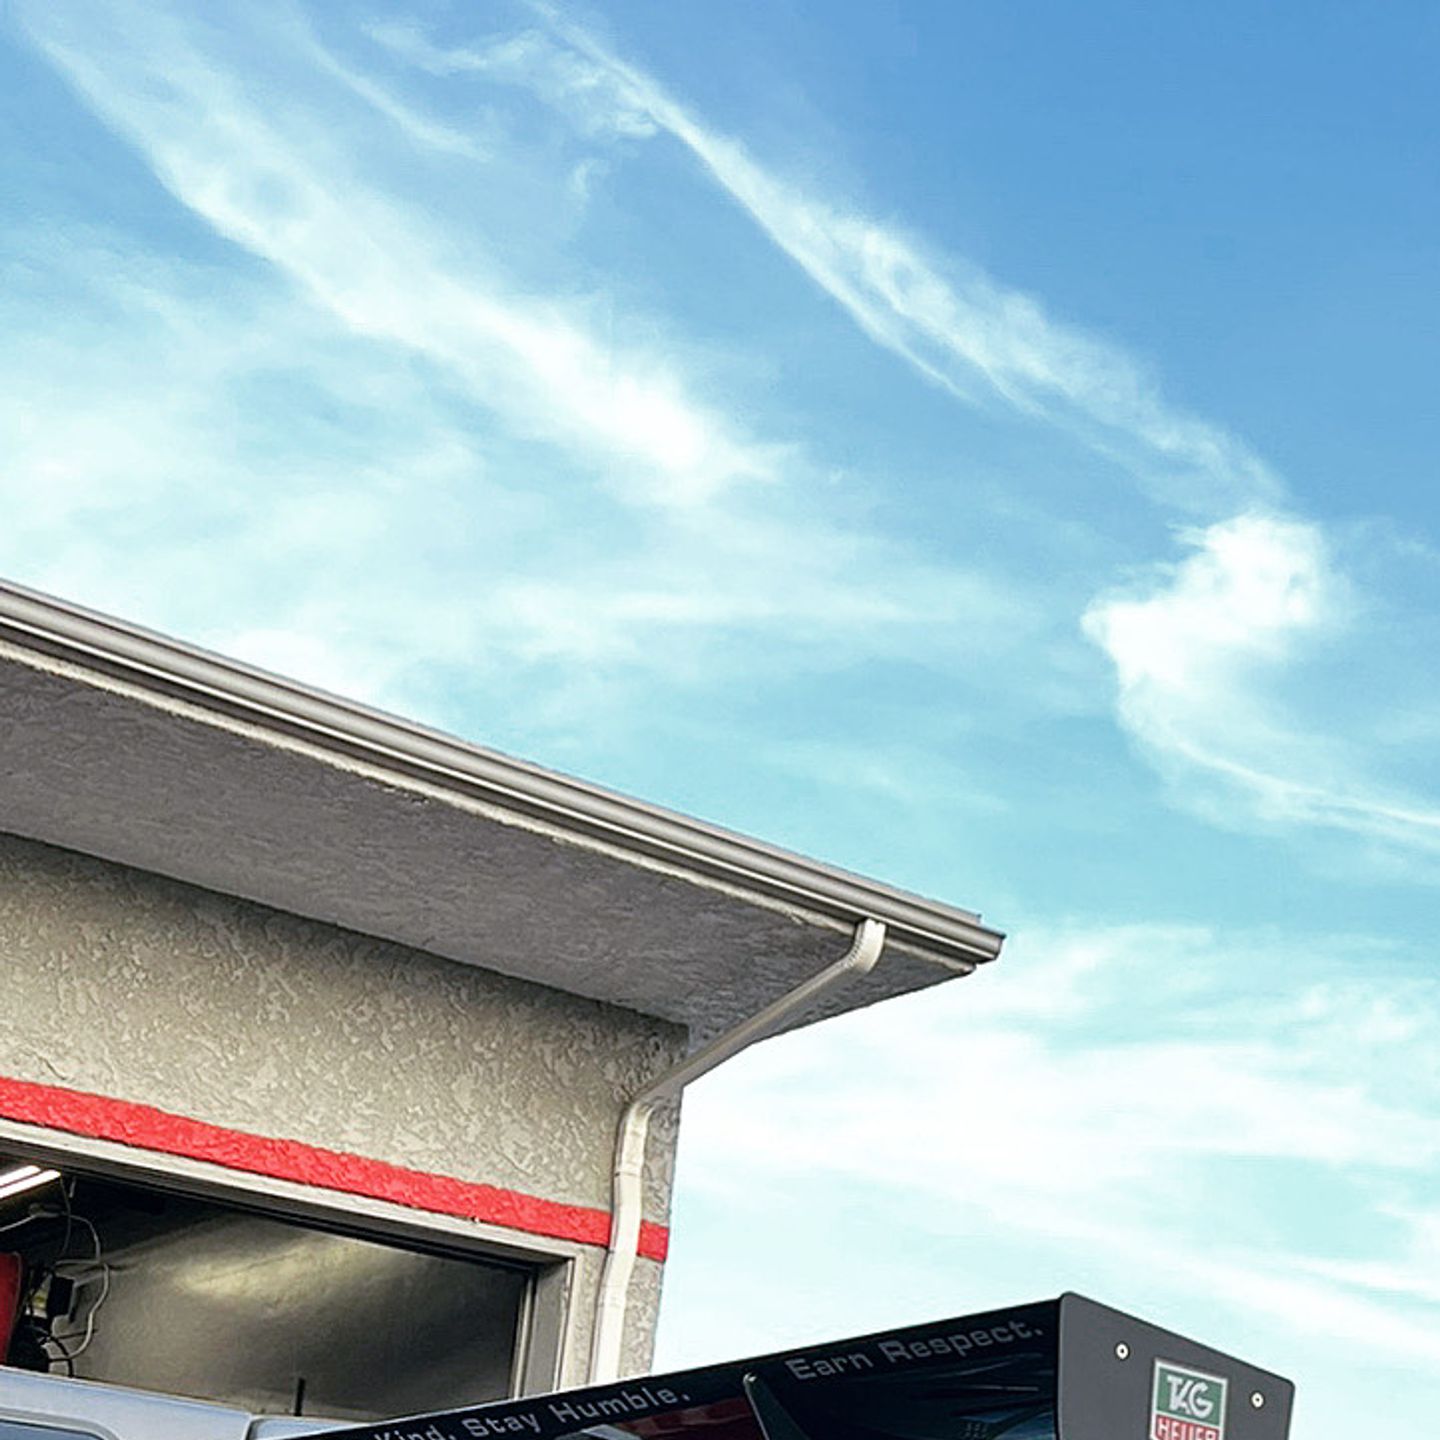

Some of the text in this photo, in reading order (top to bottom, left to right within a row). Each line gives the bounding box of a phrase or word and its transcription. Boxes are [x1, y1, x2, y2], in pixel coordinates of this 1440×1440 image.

[785, 1320, 1044, 1380] Earn Respect.
[460, 1411, 543, 1438] Stay
[548, 1386, 692, 1423] Humble.
[1166, 1375, 1215, 1418] TAG
